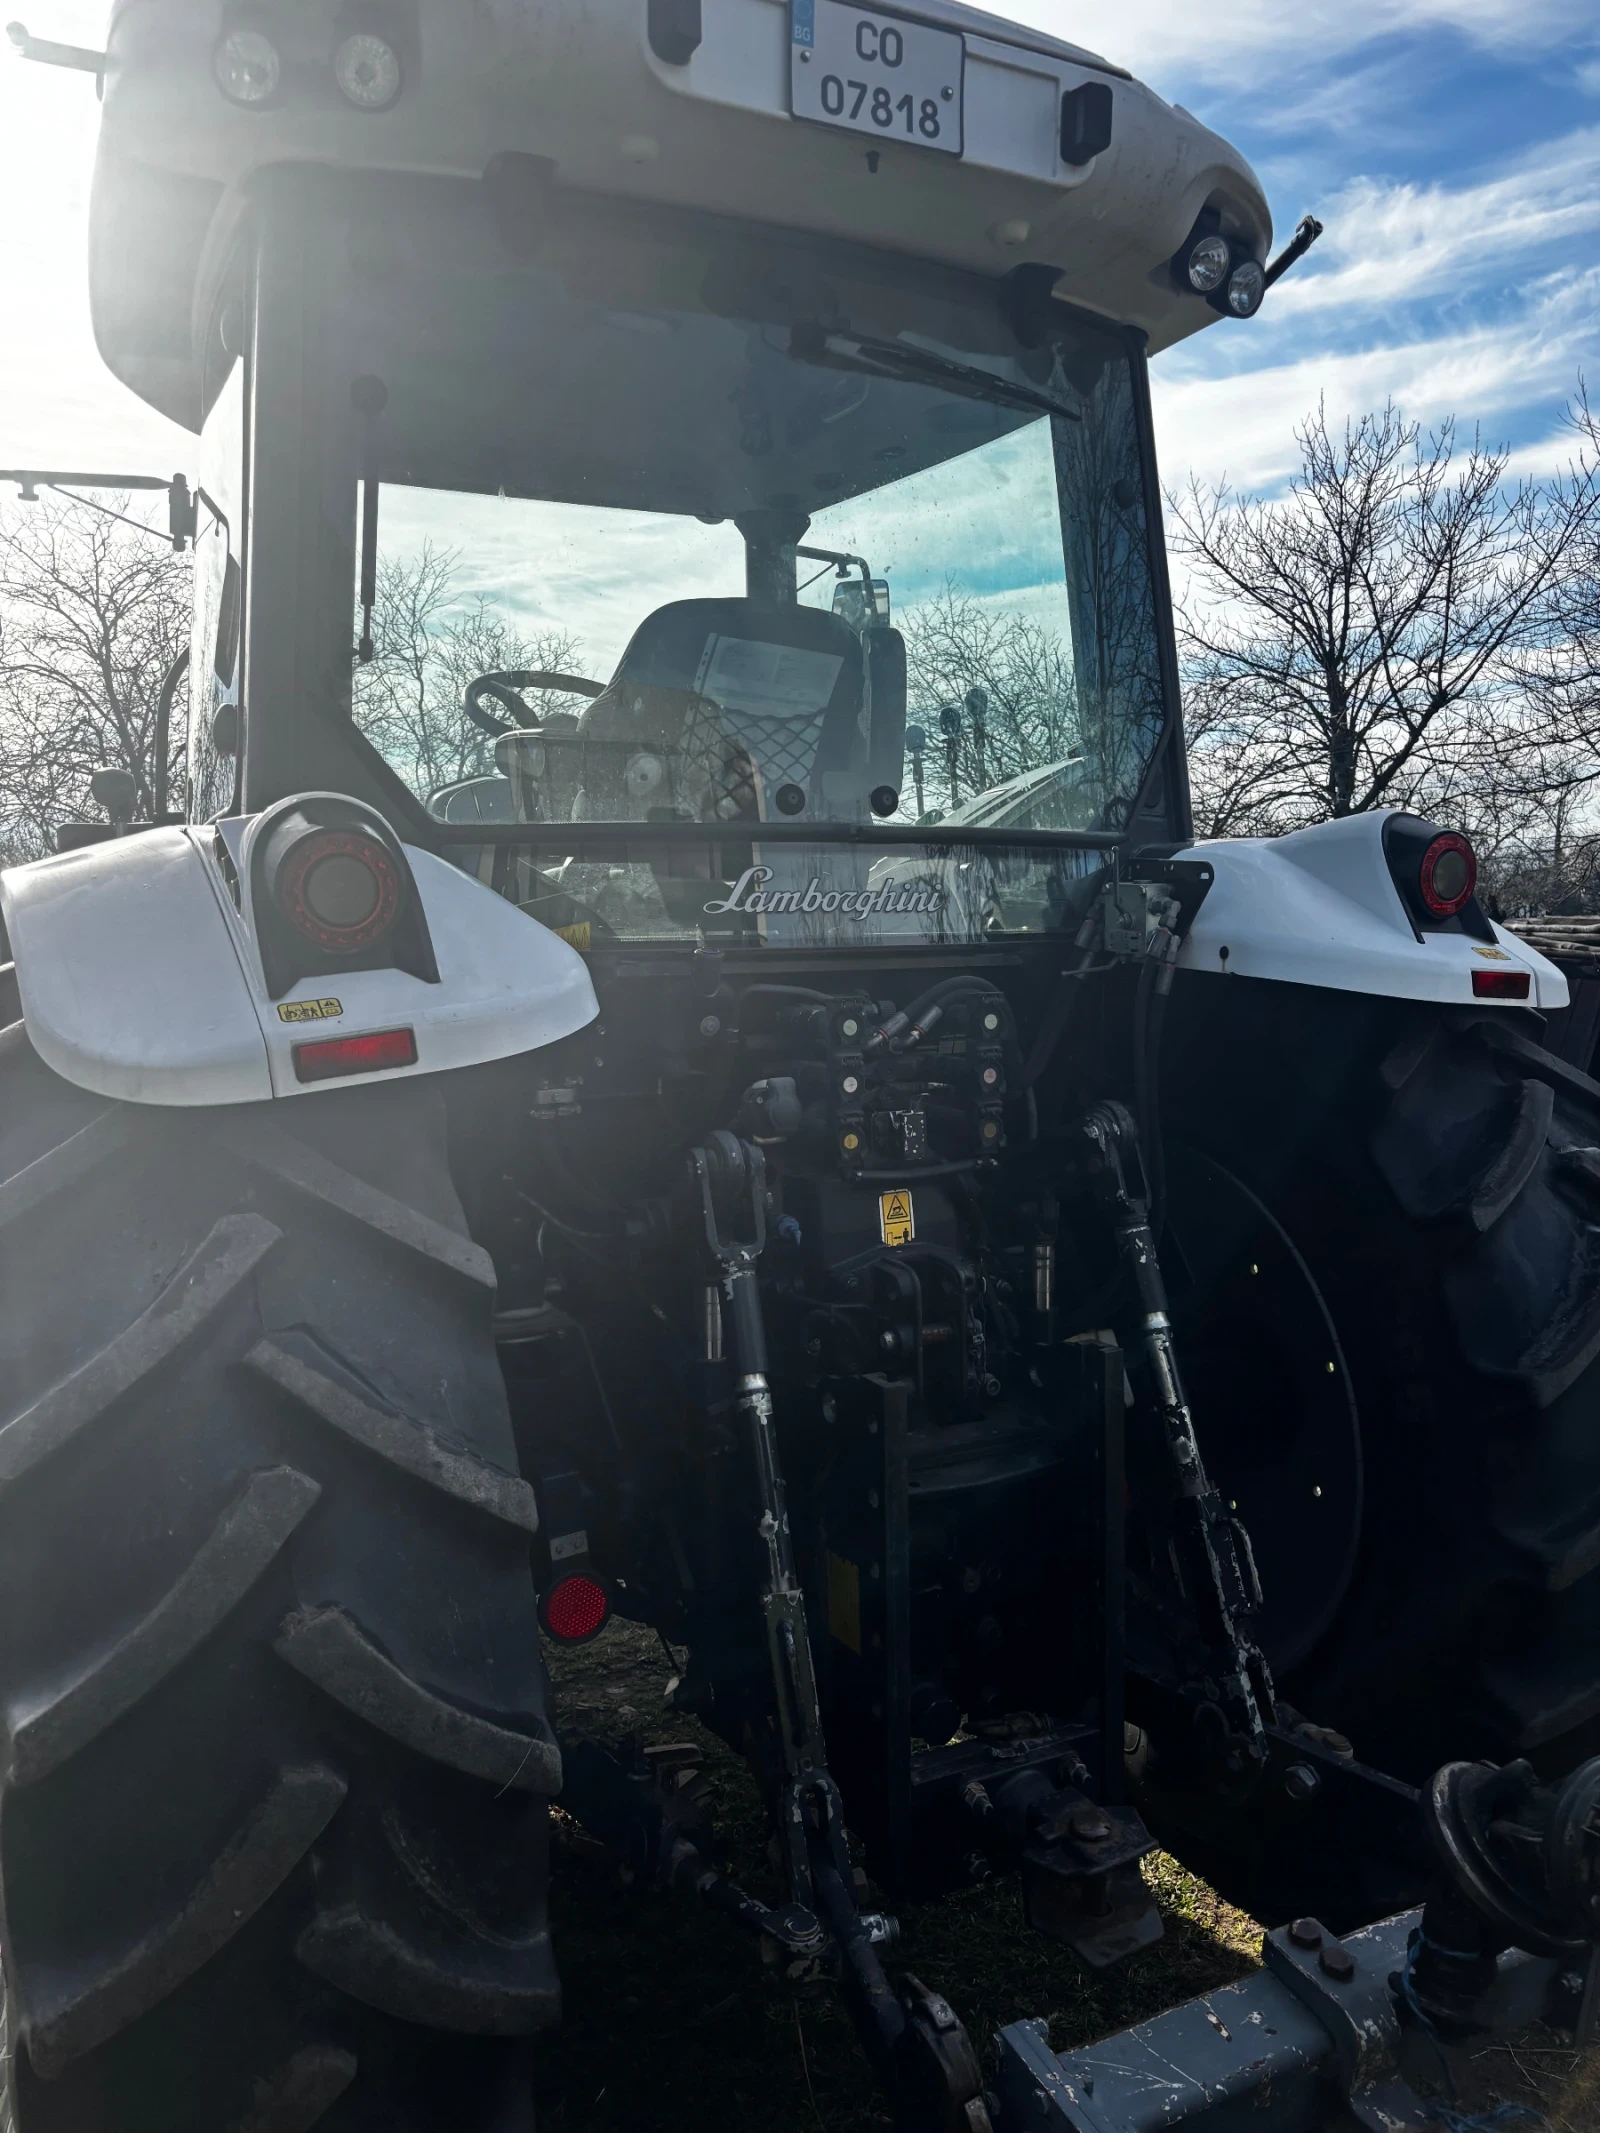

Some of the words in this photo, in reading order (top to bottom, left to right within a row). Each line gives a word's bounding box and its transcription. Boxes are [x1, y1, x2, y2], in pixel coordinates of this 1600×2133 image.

[794, 25, 811, 41] BG
[856, 20, 903, 68] CO
[821, 74, 941, 139] 07818
[702, 864, 943, 921] Lamborghini
